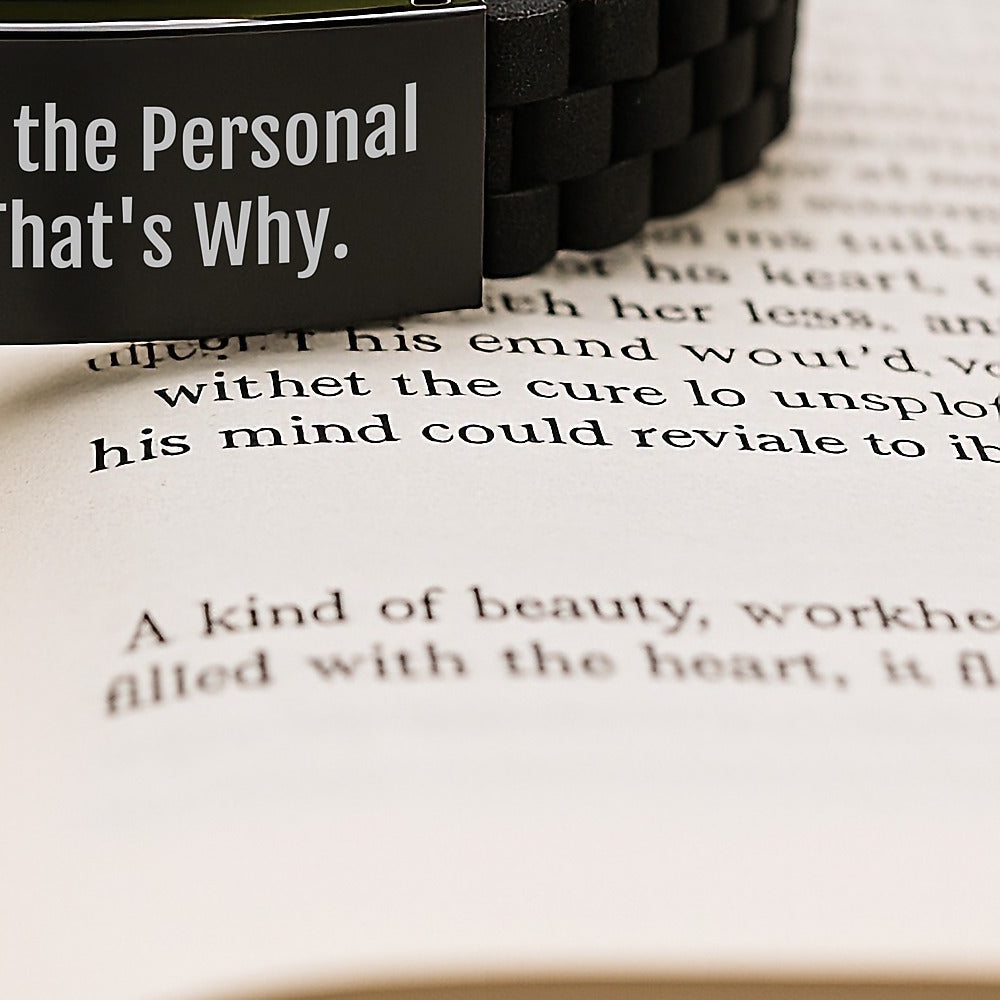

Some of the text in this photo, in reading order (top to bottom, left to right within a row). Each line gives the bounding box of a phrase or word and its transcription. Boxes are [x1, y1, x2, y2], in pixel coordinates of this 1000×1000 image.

[14, 103, 116, 171] the
[144, 82, 416, 171] Personal
[194, 196, 347, 278] Why.
[610, 295, 708, 322] her
[152, 368, 371, 407] withet
[391, 370, 501, 397] the
[527, 380, 667, 405] cure
[90, 428, 190, 473] his
[218, 414, 401, 449] mind
[422, 418, 613, 446] could
[631, 425, 848, 454] reviale
[864, 434, 925, 457] to
[130, 612, 167, 649] A
[202, 591, 346, 636] kind
[379, 585, 444, 621] of
[471, 586, 708, 633] beauty,
[310, 642, 466, 679] with
[502, 642, 611, 676] the
[643, 643, 847, 688] heart,
